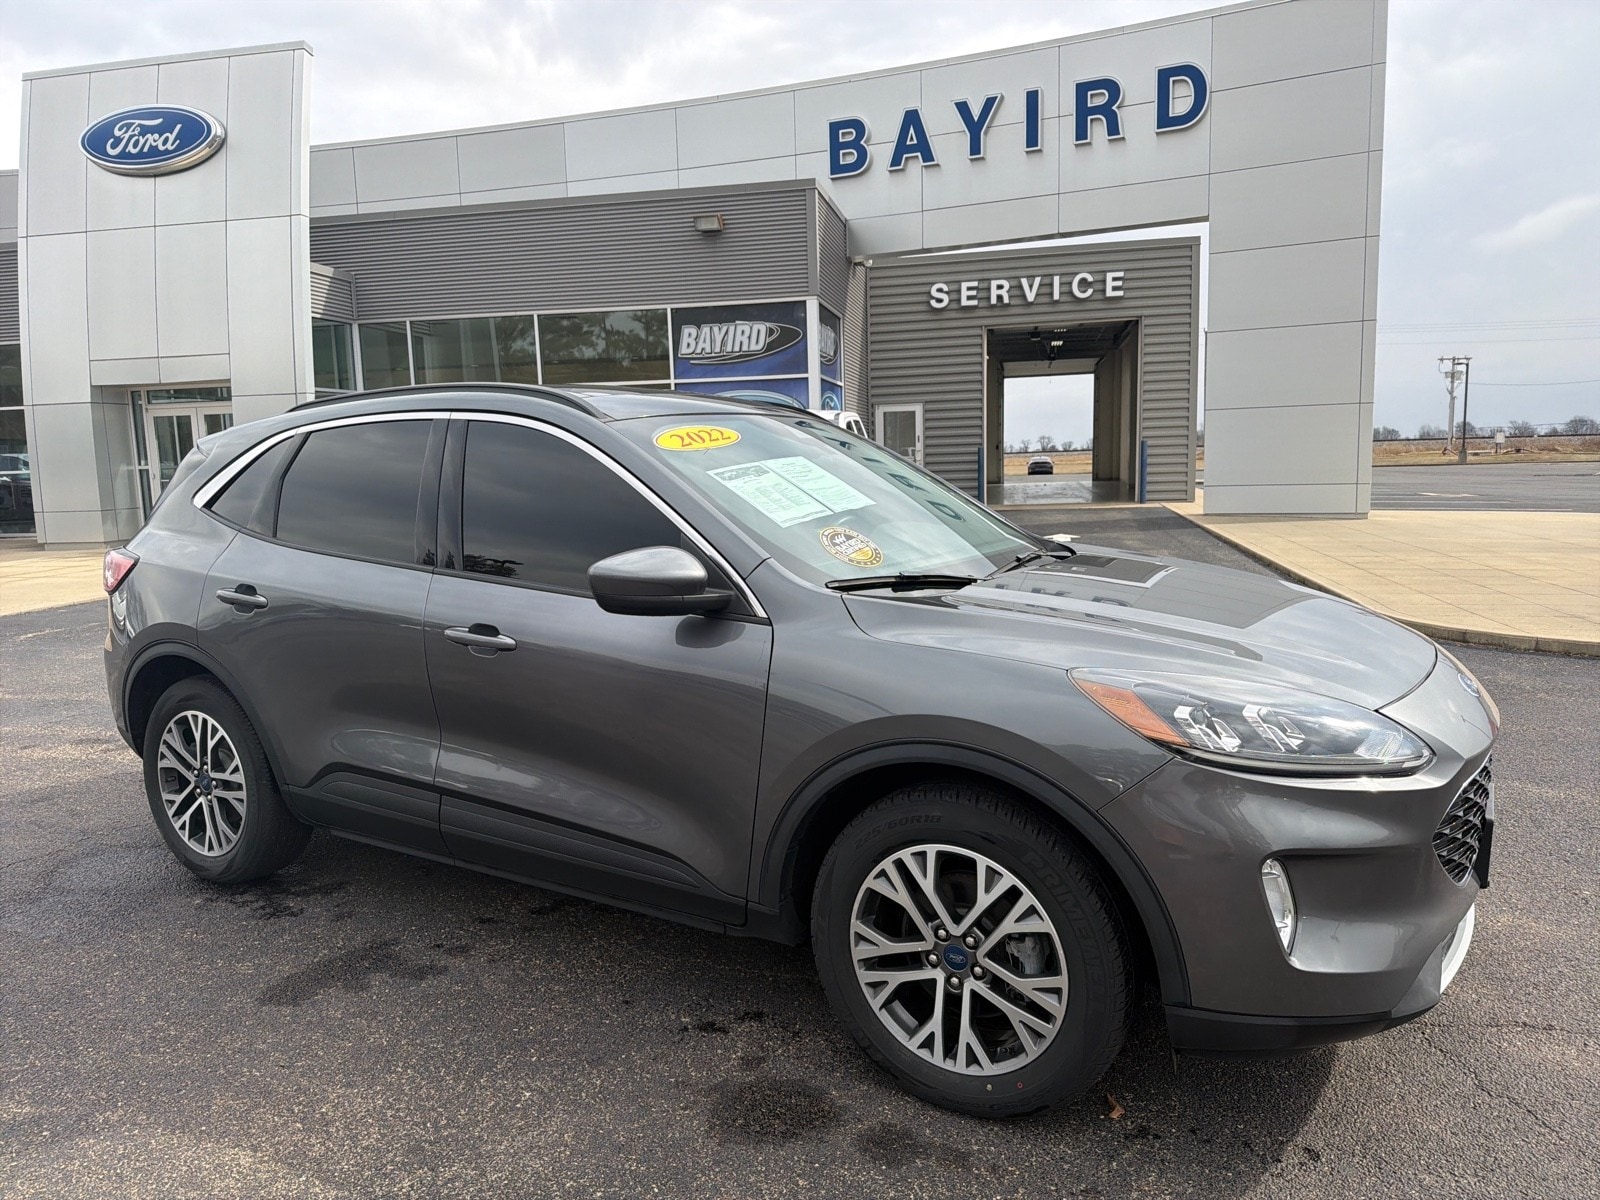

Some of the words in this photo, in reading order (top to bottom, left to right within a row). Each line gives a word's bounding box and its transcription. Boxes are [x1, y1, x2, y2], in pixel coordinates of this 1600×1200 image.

[105, 118, 182, 156] Ford
[827, 62, 1210, 179] BAYIRD
[929, 271, 1125, 309] SERVICE
[678, 321, 769, 358] BAYIRD
[670, 429, 731, 447] 2022
